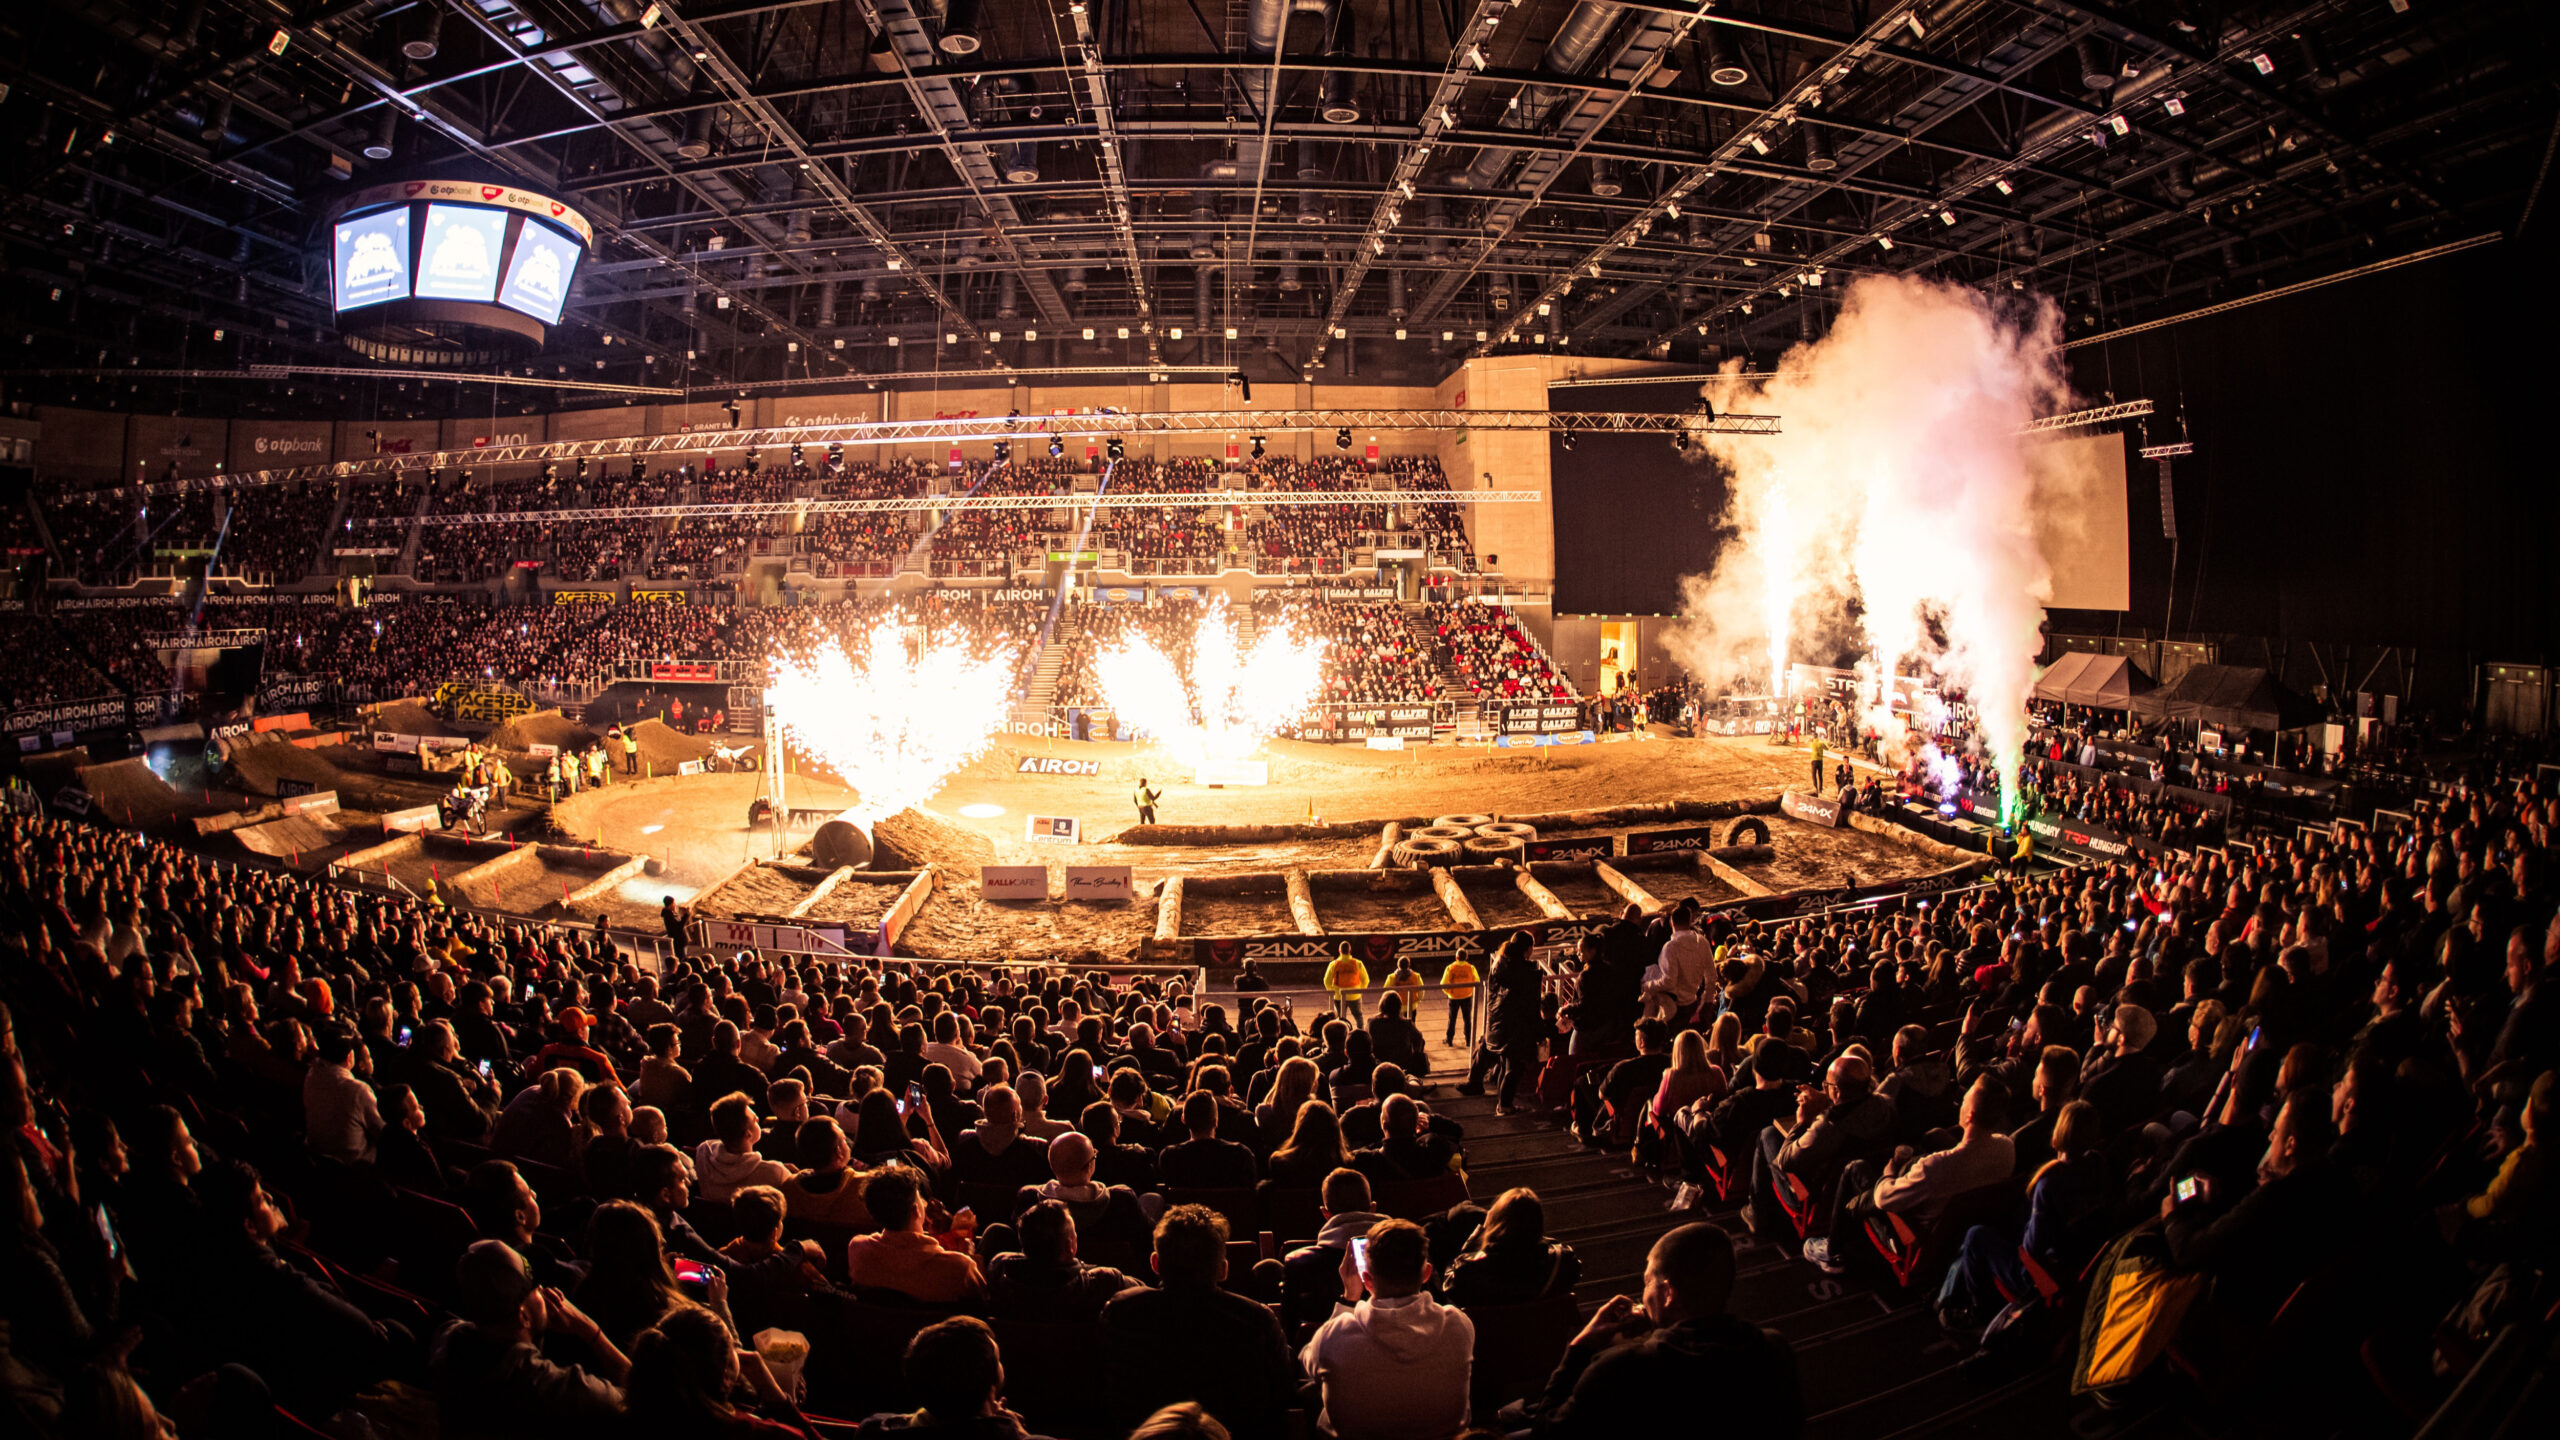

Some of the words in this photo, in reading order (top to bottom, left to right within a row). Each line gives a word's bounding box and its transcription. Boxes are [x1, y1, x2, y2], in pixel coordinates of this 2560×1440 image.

[270, 437, 323, 454] otpbank
[202, 595, 234, 605] AIROH
[235, 595, 268, 605] AIROH
[302, 594, 335, 604] AIROH
[367, 593, 400, 603] AIROH
[993, 589, 1044, 602] AIROH
[1363, 588, 1394, 598] GALFER
[56, 599, 84, 610] AIROH
[85, 598, 114, 609] AIROH
[161, 637, 196, 649] AIROH
[196, 635, 230, 648] AIROH
[54, 704, 89, 722] AIROH
[90, 701, 125, 717] AIROH
[1390, 709, 1429, 720] GALFER
[1543, 707, 1579, 717] GALFER
[1541, 719, 1577, 729] GALFER
[211, 723, 249, 740] AIROH
[1392, 727, 1431, 737] GALFER
[376, 733, 396, 745] KTM
[1018, 757, 1101, 775] AIROH
[1797, 802, 1833, 819] 24MX
[1973, 805, 1997, 819] motam
[1653, 836, 1702, 851] 24MX
[2064, 829, 2090, 845] TRP
[2089, 837, 2129, 856] HUNGARY
[1798, 892, 1842, 908] 24M
[1245, 941, 1331, 957] 24MX
[1399, 934, 1482, 952] 24MX
